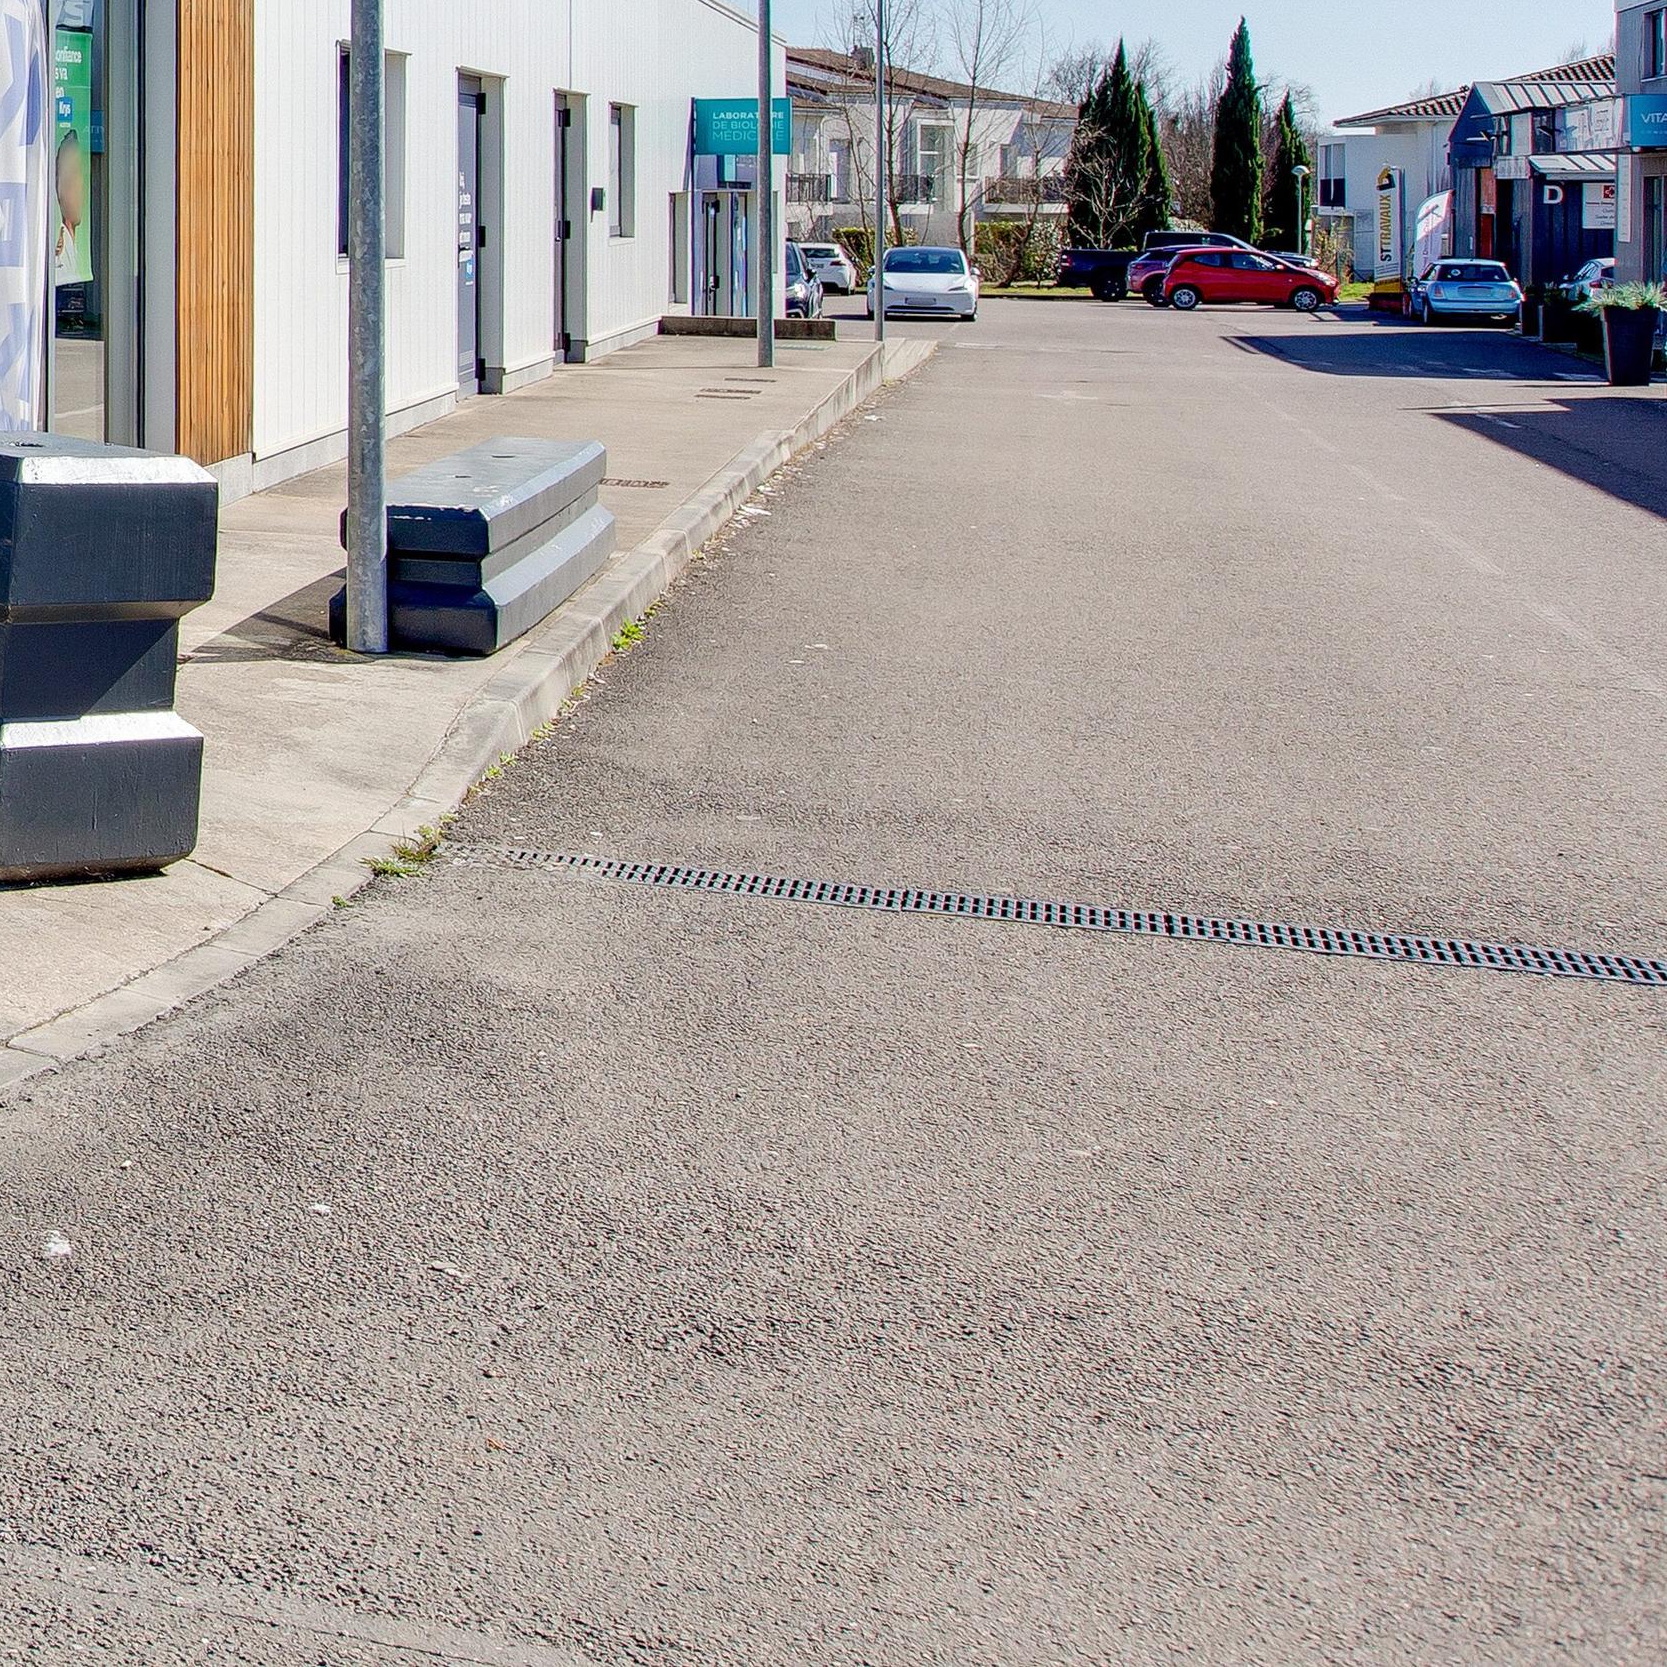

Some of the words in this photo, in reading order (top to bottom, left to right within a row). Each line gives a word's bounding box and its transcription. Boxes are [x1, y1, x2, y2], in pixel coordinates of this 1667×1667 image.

[713, 121, 727, 129] DE
[731, 121, 784, 130] BIOLIE
[713, 130, 784, 141] MÉDICE
[1542, 184, 1564, 205] D
